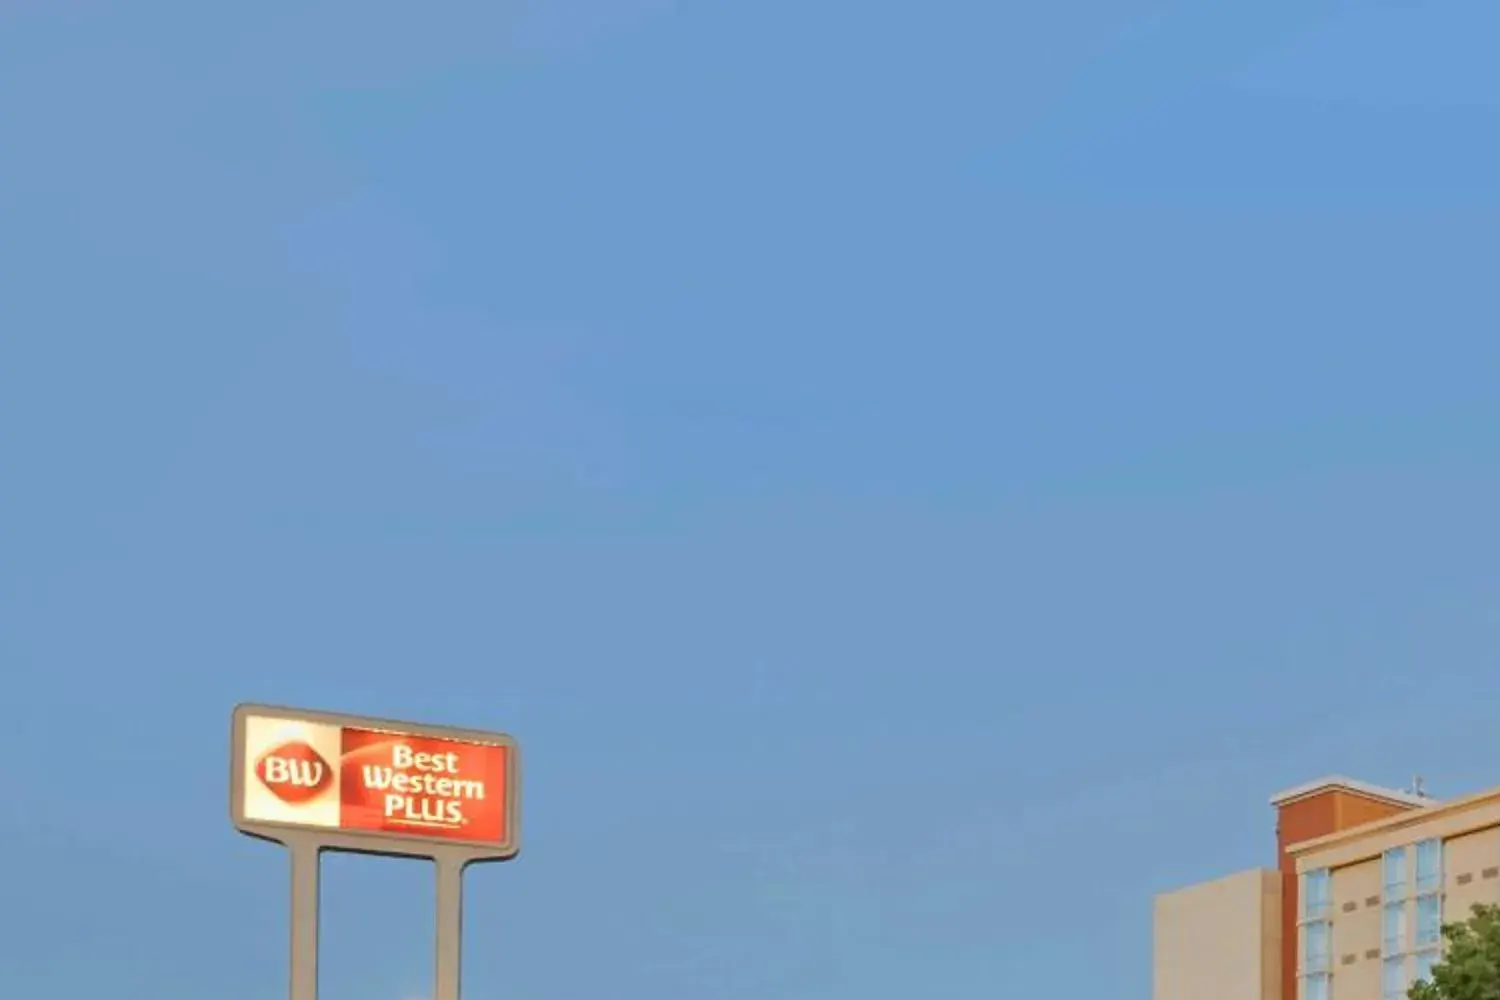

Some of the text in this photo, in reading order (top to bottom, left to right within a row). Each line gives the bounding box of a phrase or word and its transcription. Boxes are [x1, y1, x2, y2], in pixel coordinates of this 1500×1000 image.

[265, 757, 322, 787] BW
[393, 745, 458, 774] Best
[363, 766, 484, 799] Western
